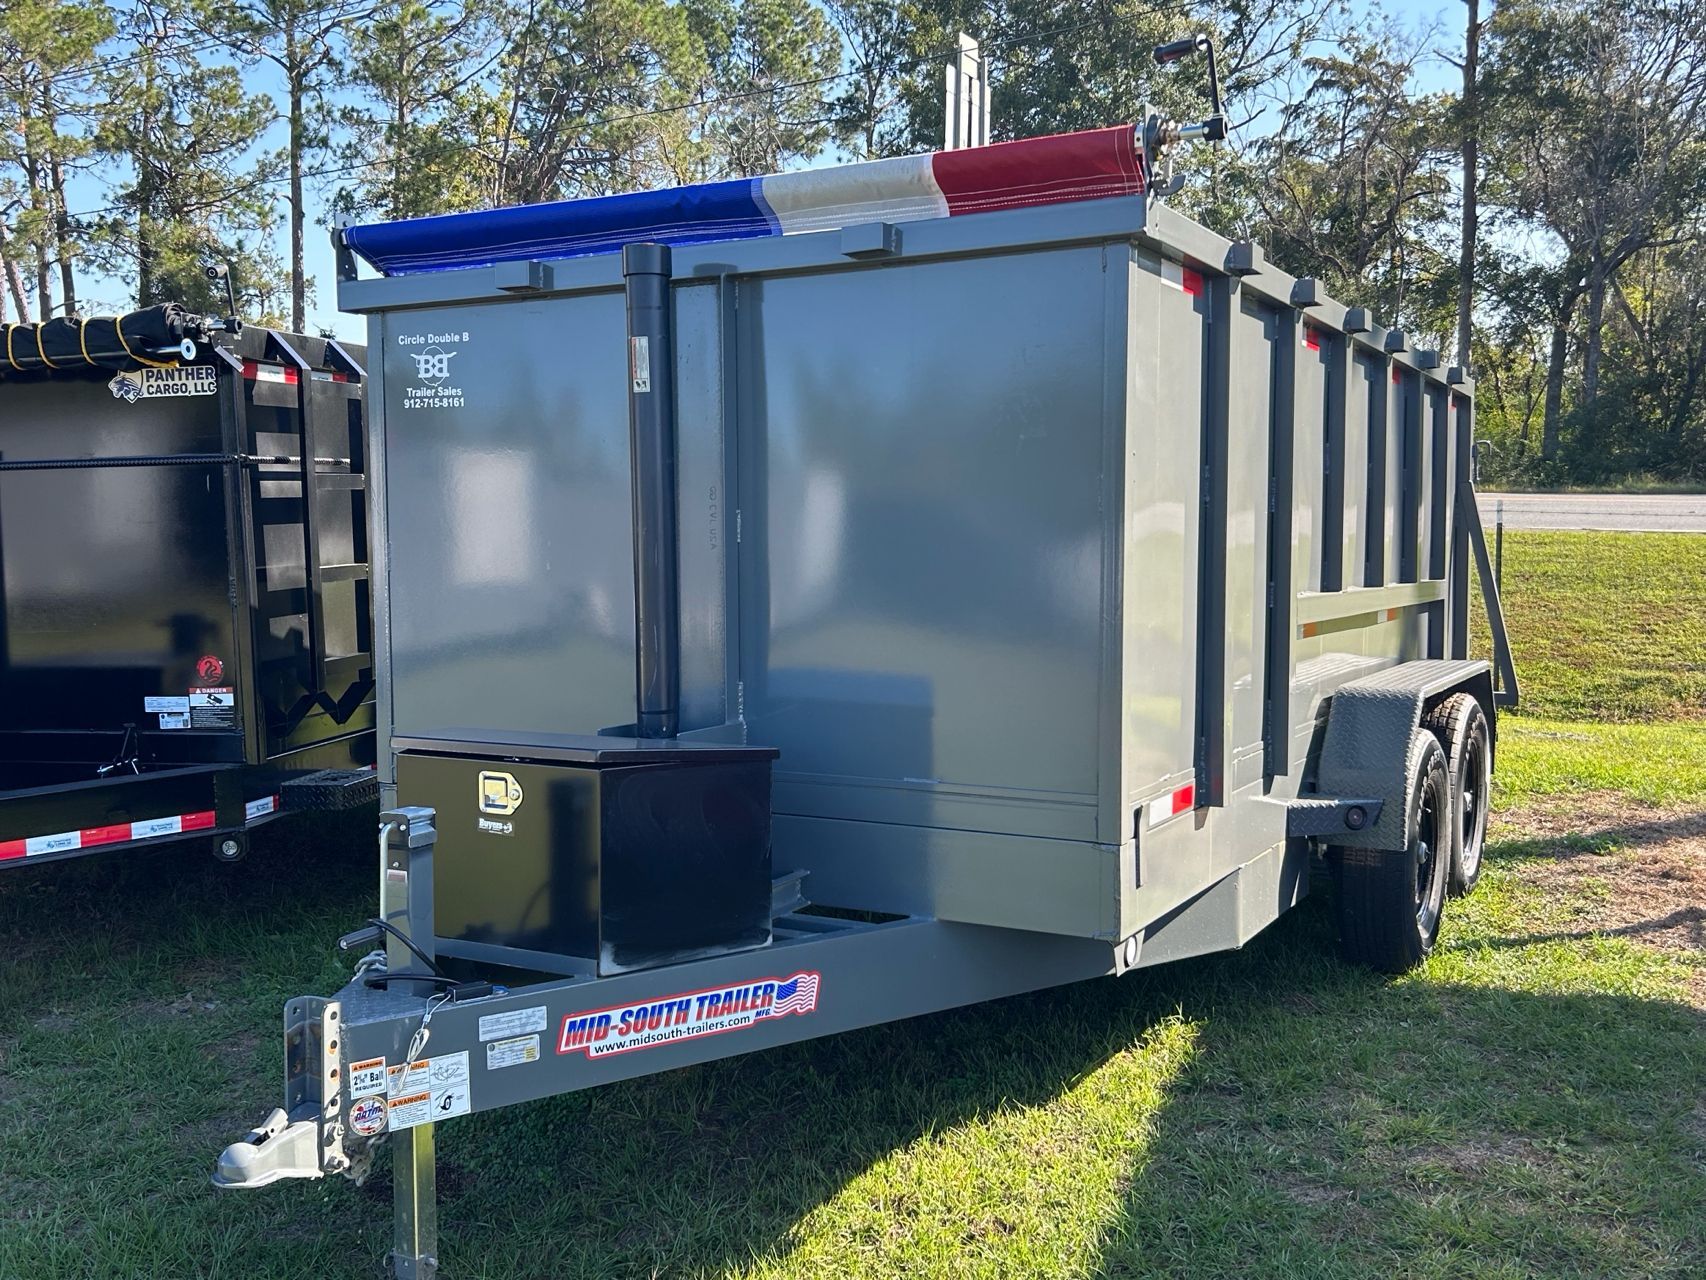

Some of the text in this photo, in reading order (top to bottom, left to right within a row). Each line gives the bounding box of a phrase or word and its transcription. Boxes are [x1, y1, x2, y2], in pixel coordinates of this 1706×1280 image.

[398, 332, 469, 345] Circle Double B
[145, 366, 215, 382] PANTHER
[146, 382, 216, 395] CARGO, LLC
[406, 386, 462, 397] Trailer Sales
[403, 397, 465, 408] 912-715-8161
[564, 1001, 691, 1048] MID-SOUTH
[695, 982, 776, 1021] TRAILER
[754, 1008, 772, 1019] MFG.
[594, 1015, 750, 1054] www.midsouth-trailers.com
[370, 1070, 384, 1082] Ball
[397, 1093, 427, 1105] WARNING
